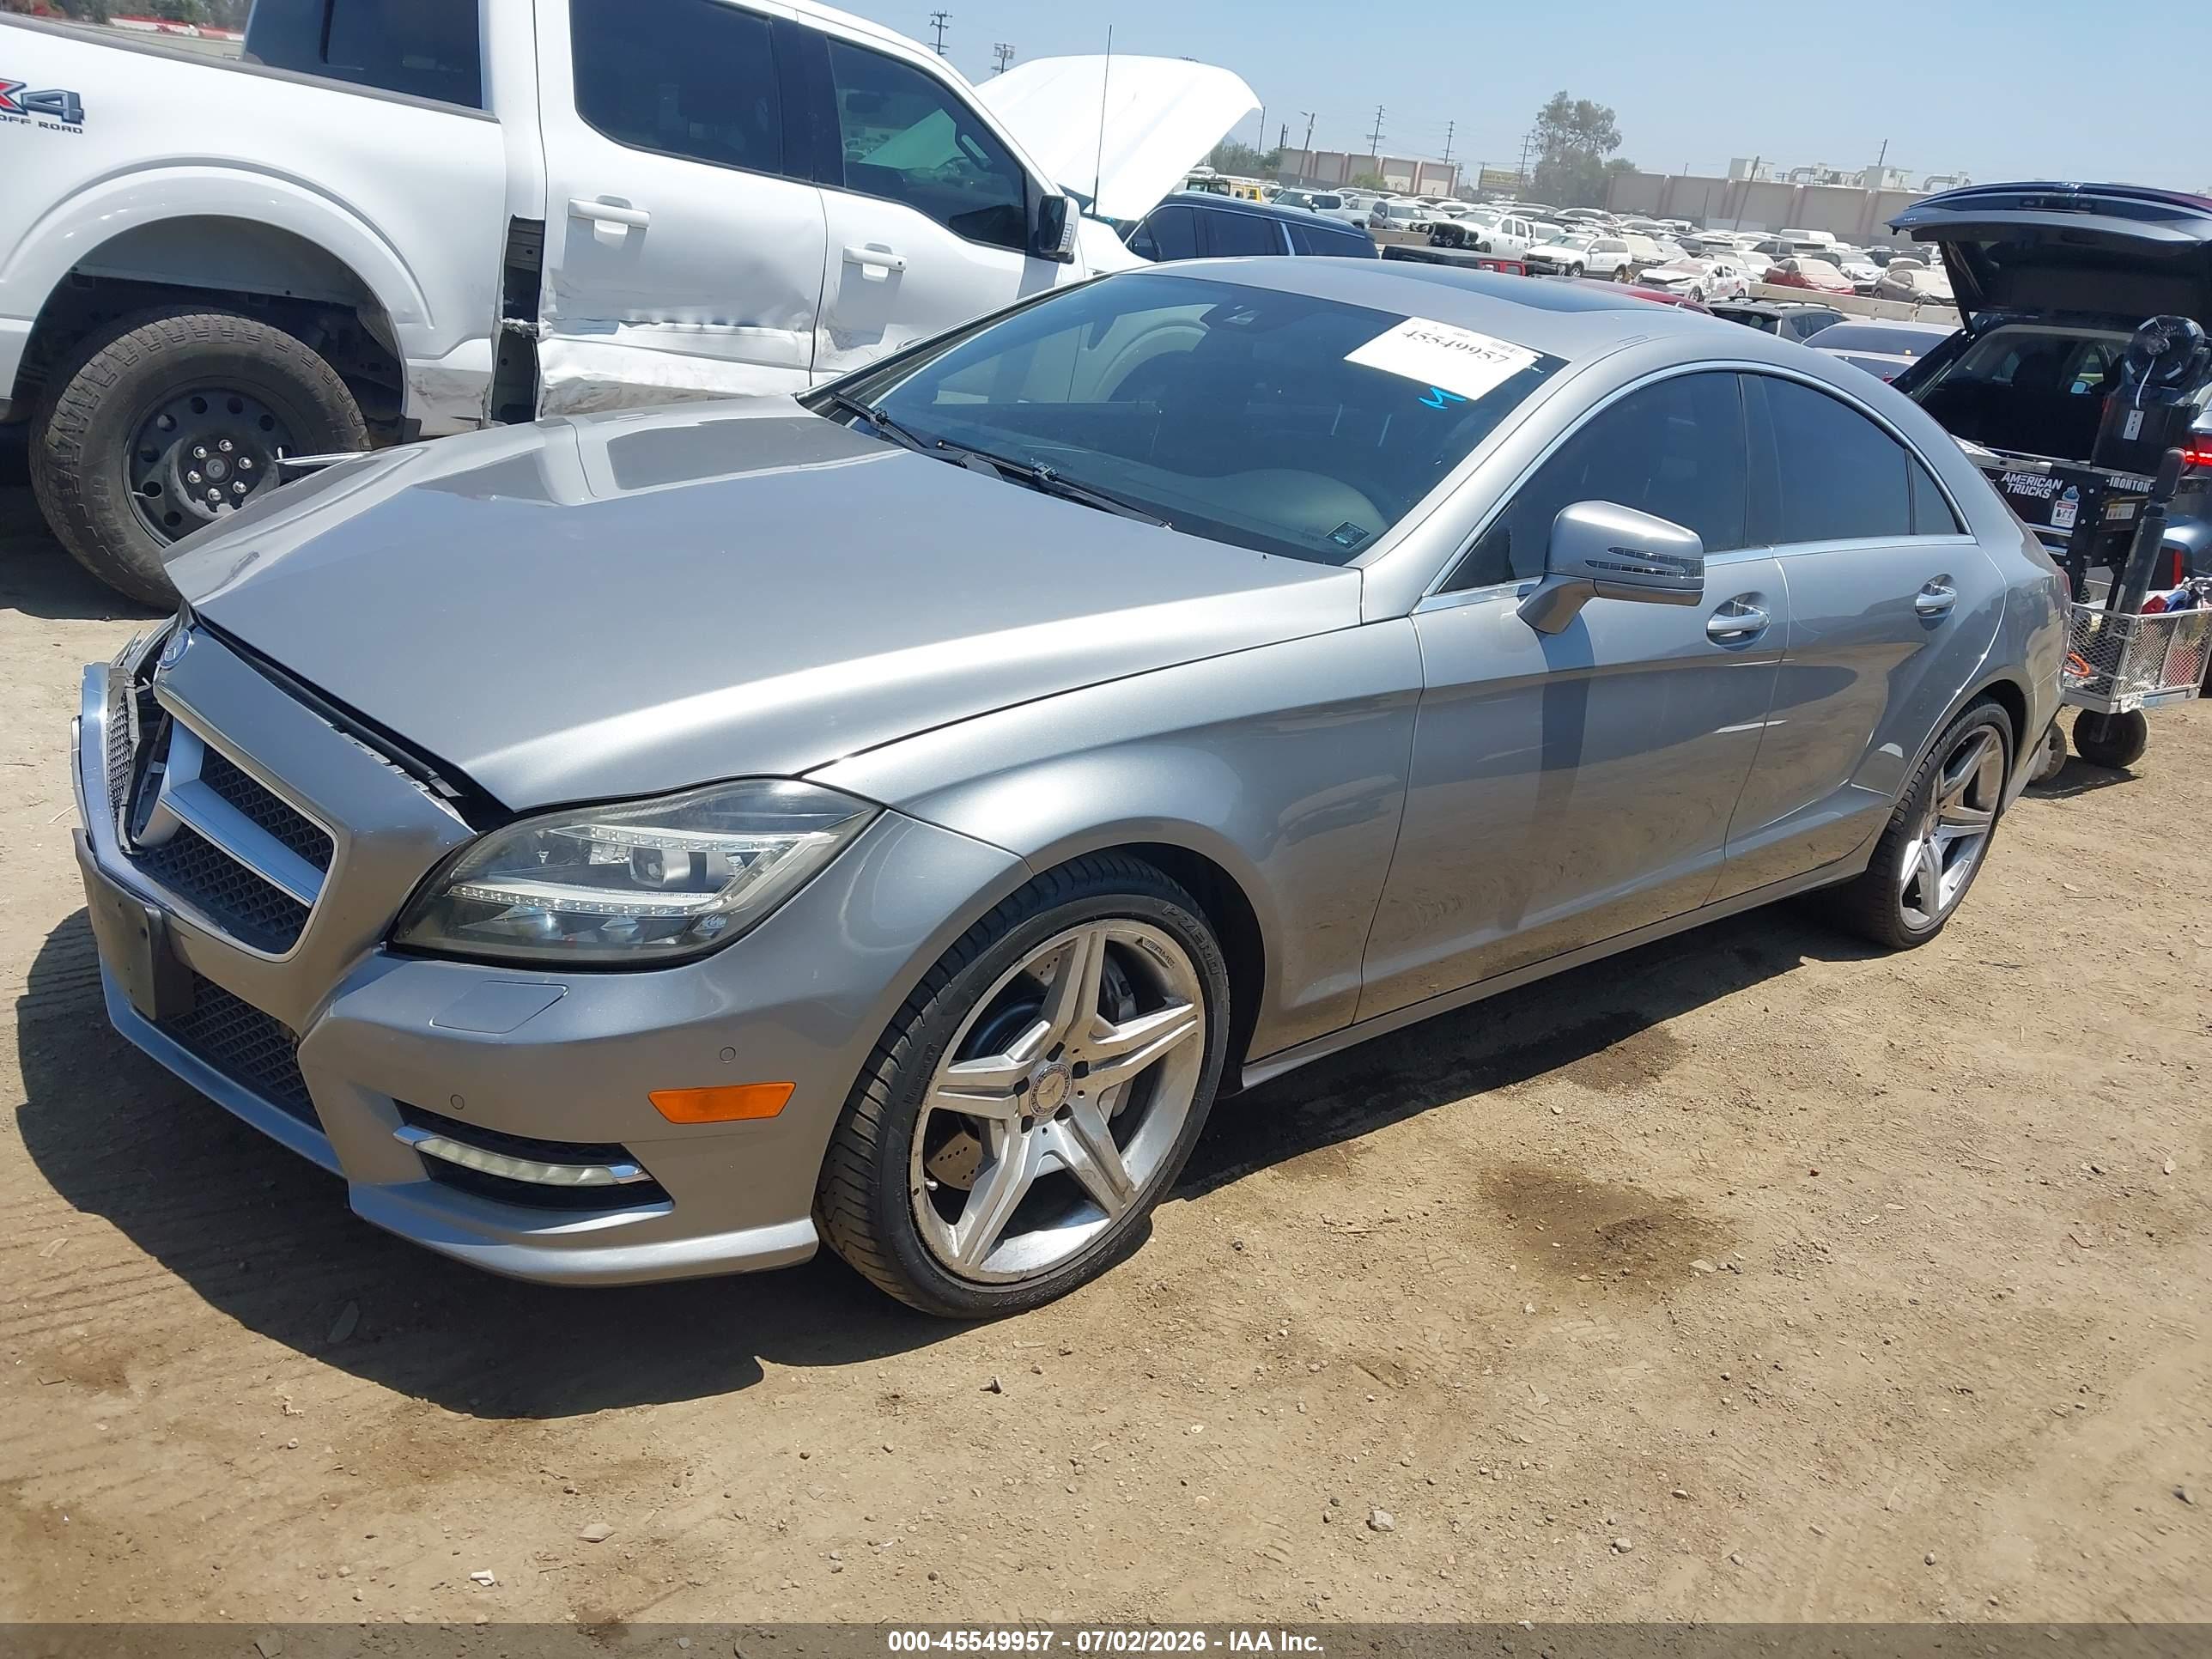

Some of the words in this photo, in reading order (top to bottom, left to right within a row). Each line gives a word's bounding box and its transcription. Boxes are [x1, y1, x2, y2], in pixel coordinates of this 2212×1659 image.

[38, 121, 83, 134] ROAD
[1401, 330, 1510, 364] 45549957
[2001, 472, 2063, 490] AMERICAN
[2109, 476, 2150, 493] IRONTON
[2006, 483, 2052, 499] TRUCKS
